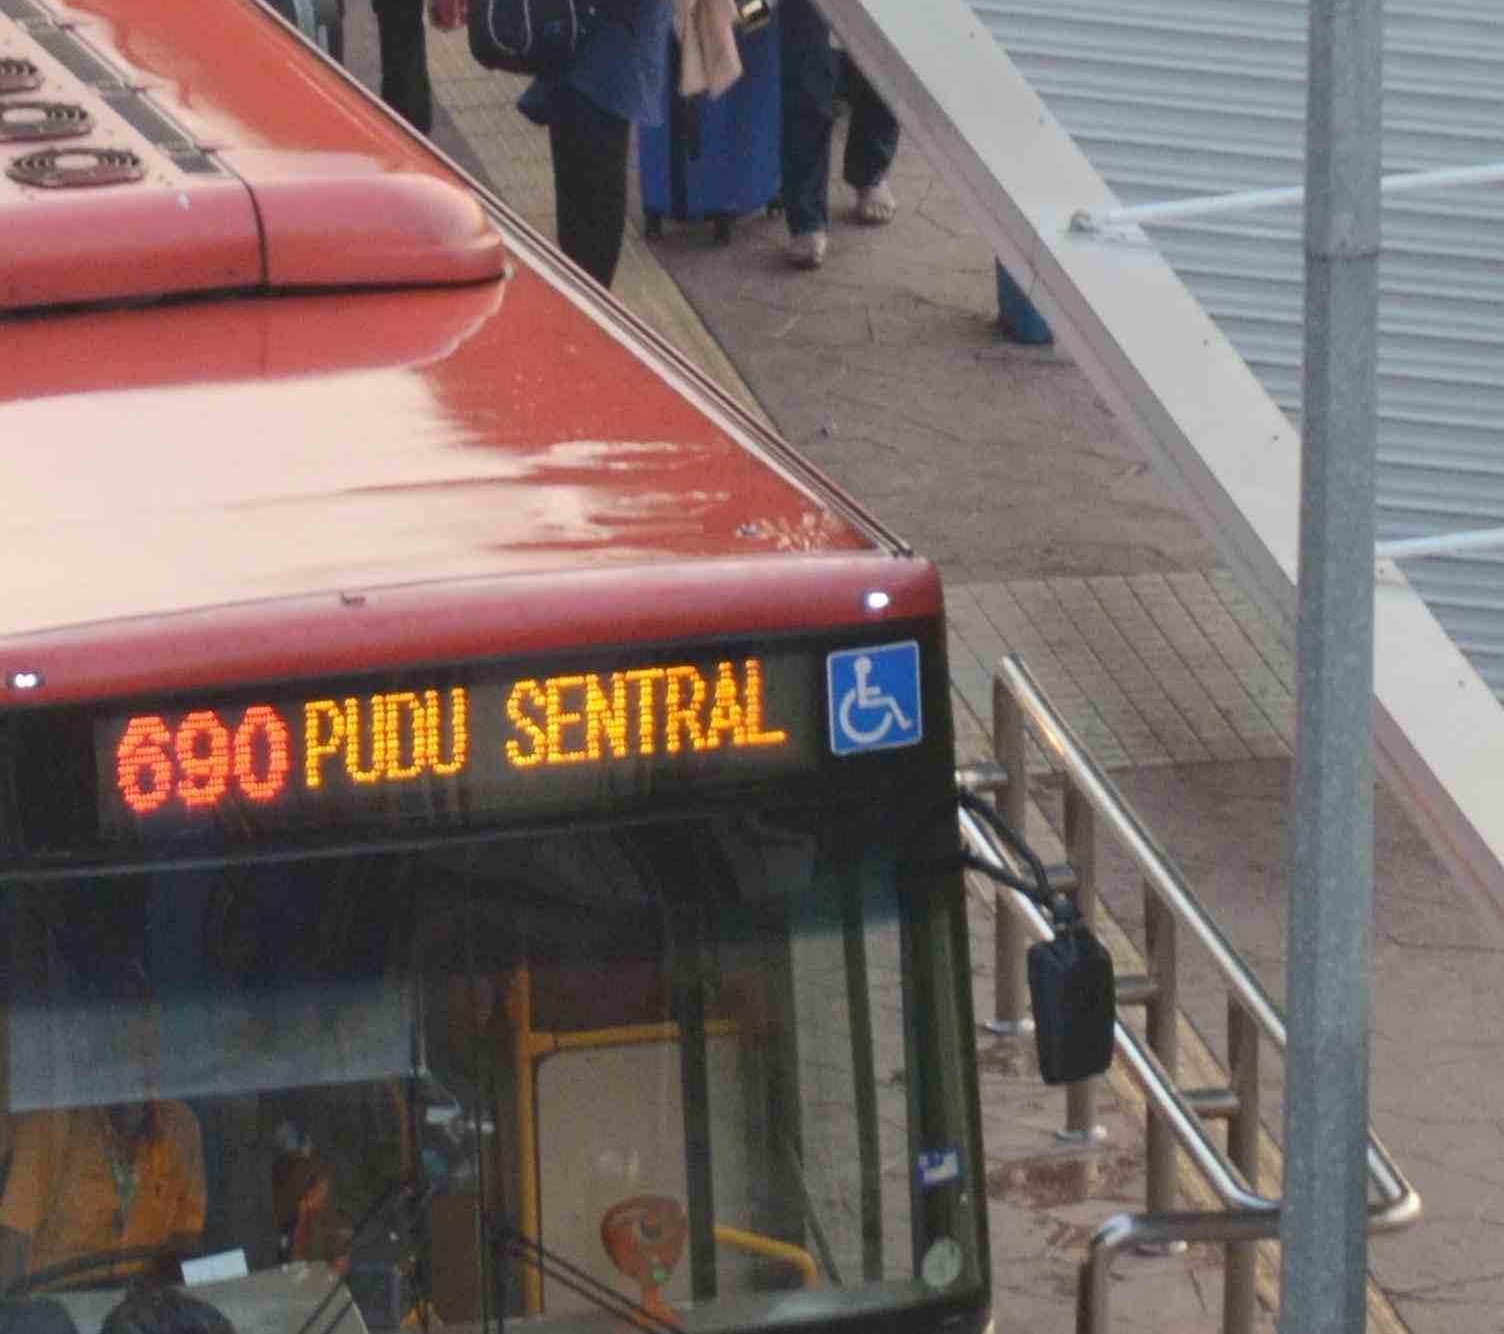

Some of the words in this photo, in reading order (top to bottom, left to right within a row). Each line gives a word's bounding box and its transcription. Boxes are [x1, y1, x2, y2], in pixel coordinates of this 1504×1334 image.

[117, 706, 288, 814] 690
[304, 686, 469, 787] PUDU
[505, 659, 787, 768] SENTRAL
